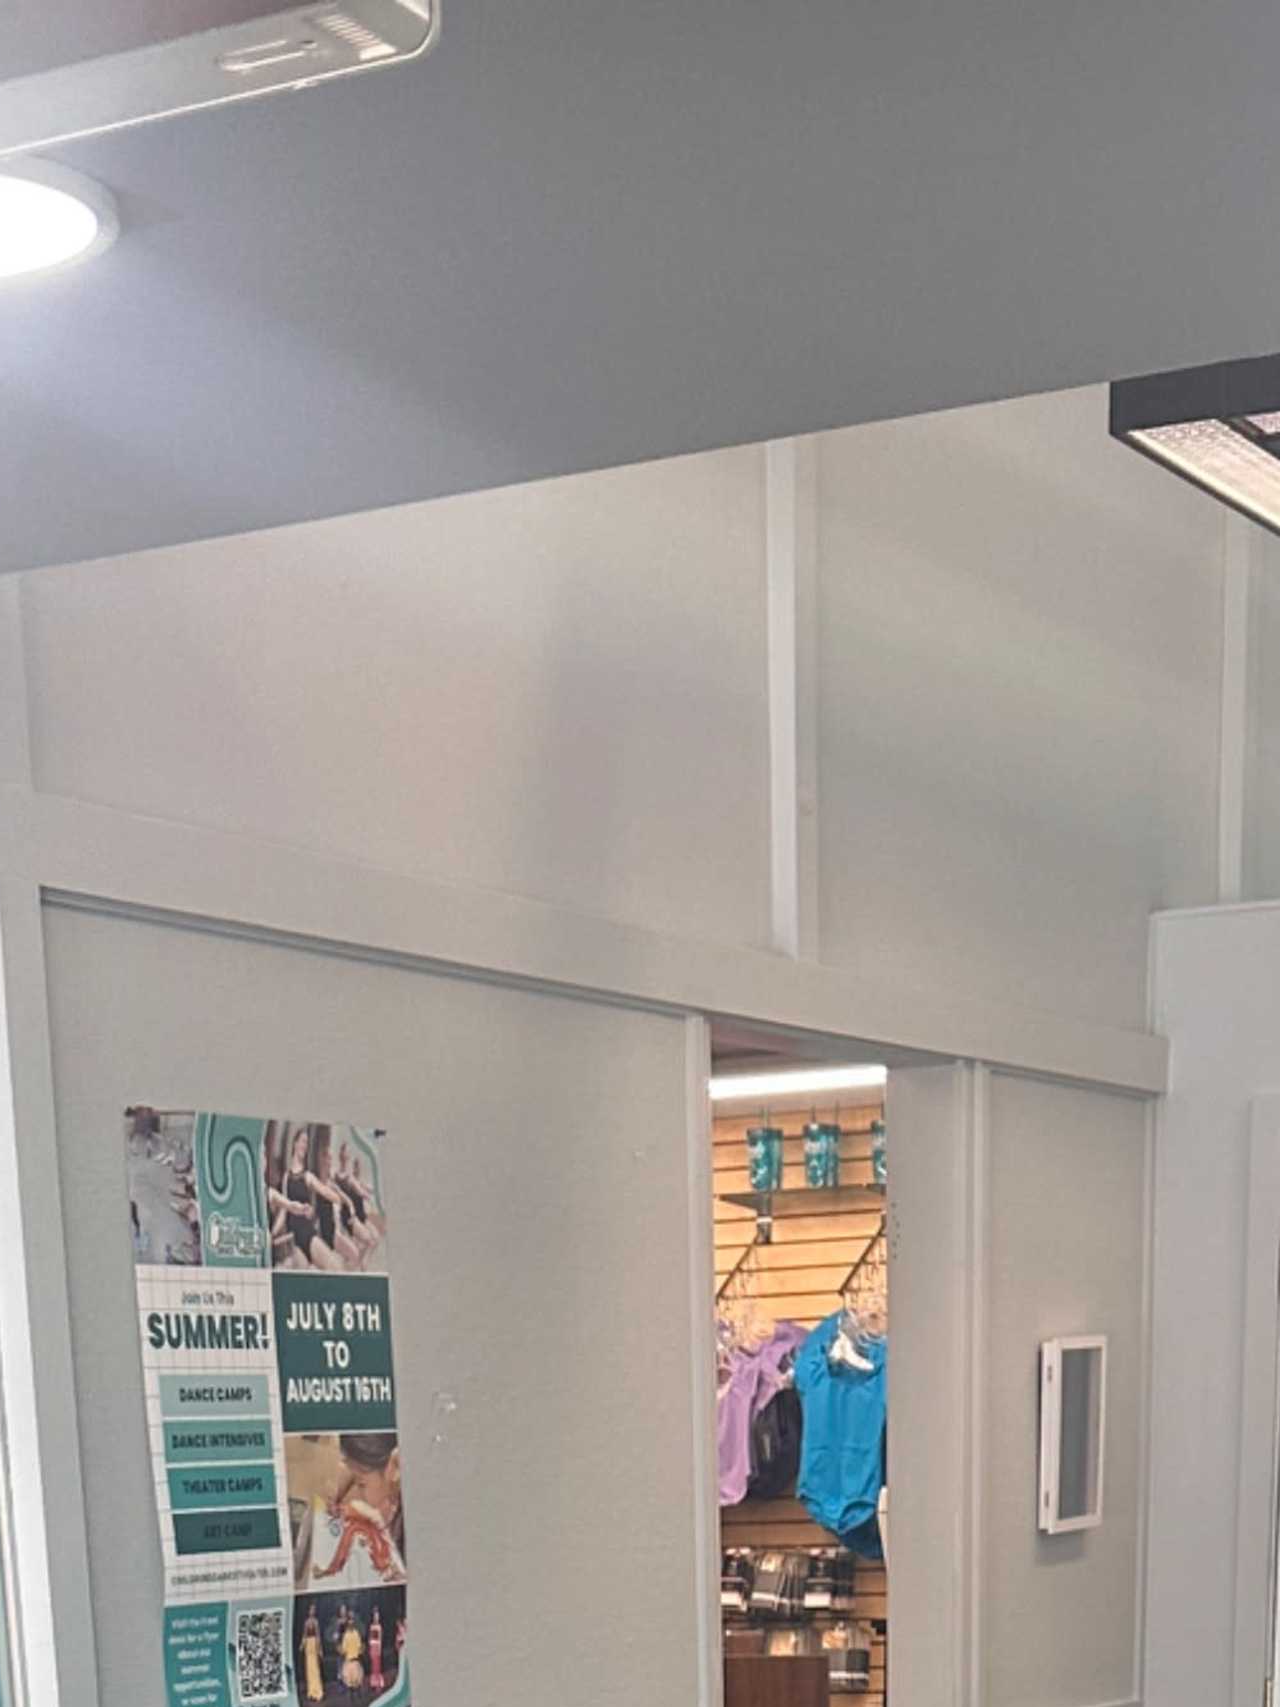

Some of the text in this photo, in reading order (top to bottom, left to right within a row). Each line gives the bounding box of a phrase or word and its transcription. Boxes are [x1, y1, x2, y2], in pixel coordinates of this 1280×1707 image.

[286, 1302, 382, 1331] JULY 8TH
[147, 1312, 270, 1350] SUMMER!
[323, 1341, 350, 1368] TO
[179, 1387, 252, 1402] DANCE CAMPS
[286, 1377, 393, 1402] AUGUST 16TH
[172, 1431, 266, 1449] DANCE INTENSIVES
[228, 1477, 263, 1492] CAMPS
